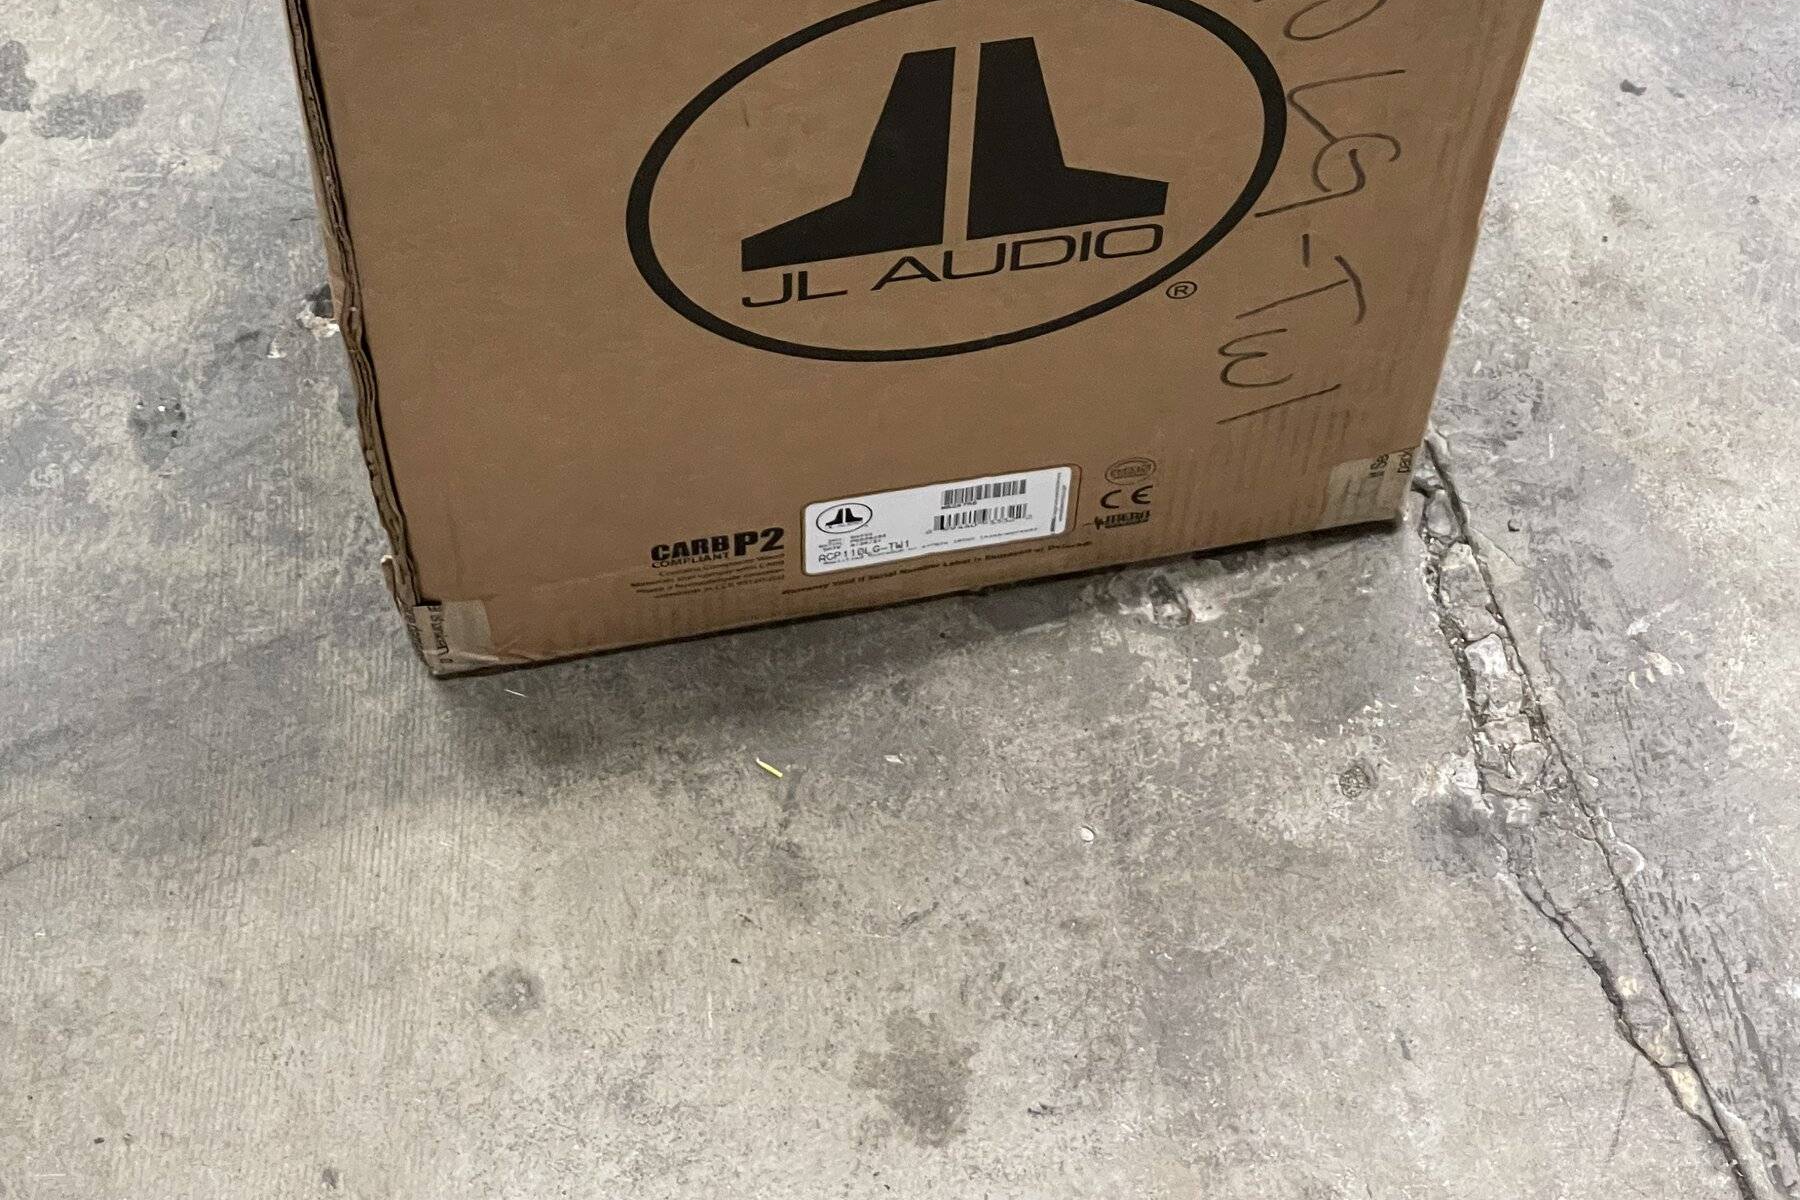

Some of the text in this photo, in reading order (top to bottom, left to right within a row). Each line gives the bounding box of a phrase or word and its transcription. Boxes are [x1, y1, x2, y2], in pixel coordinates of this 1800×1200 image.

[741, 268, 849, 308] JL
[870, 222, 1165, 293] AUDIO
[1100, 485, 1153, 509] CE
[650, 535, 730, 561] CARB
[733, 527, 785, 557] P2
[651, 551, 730, 568] COMPLIANT
